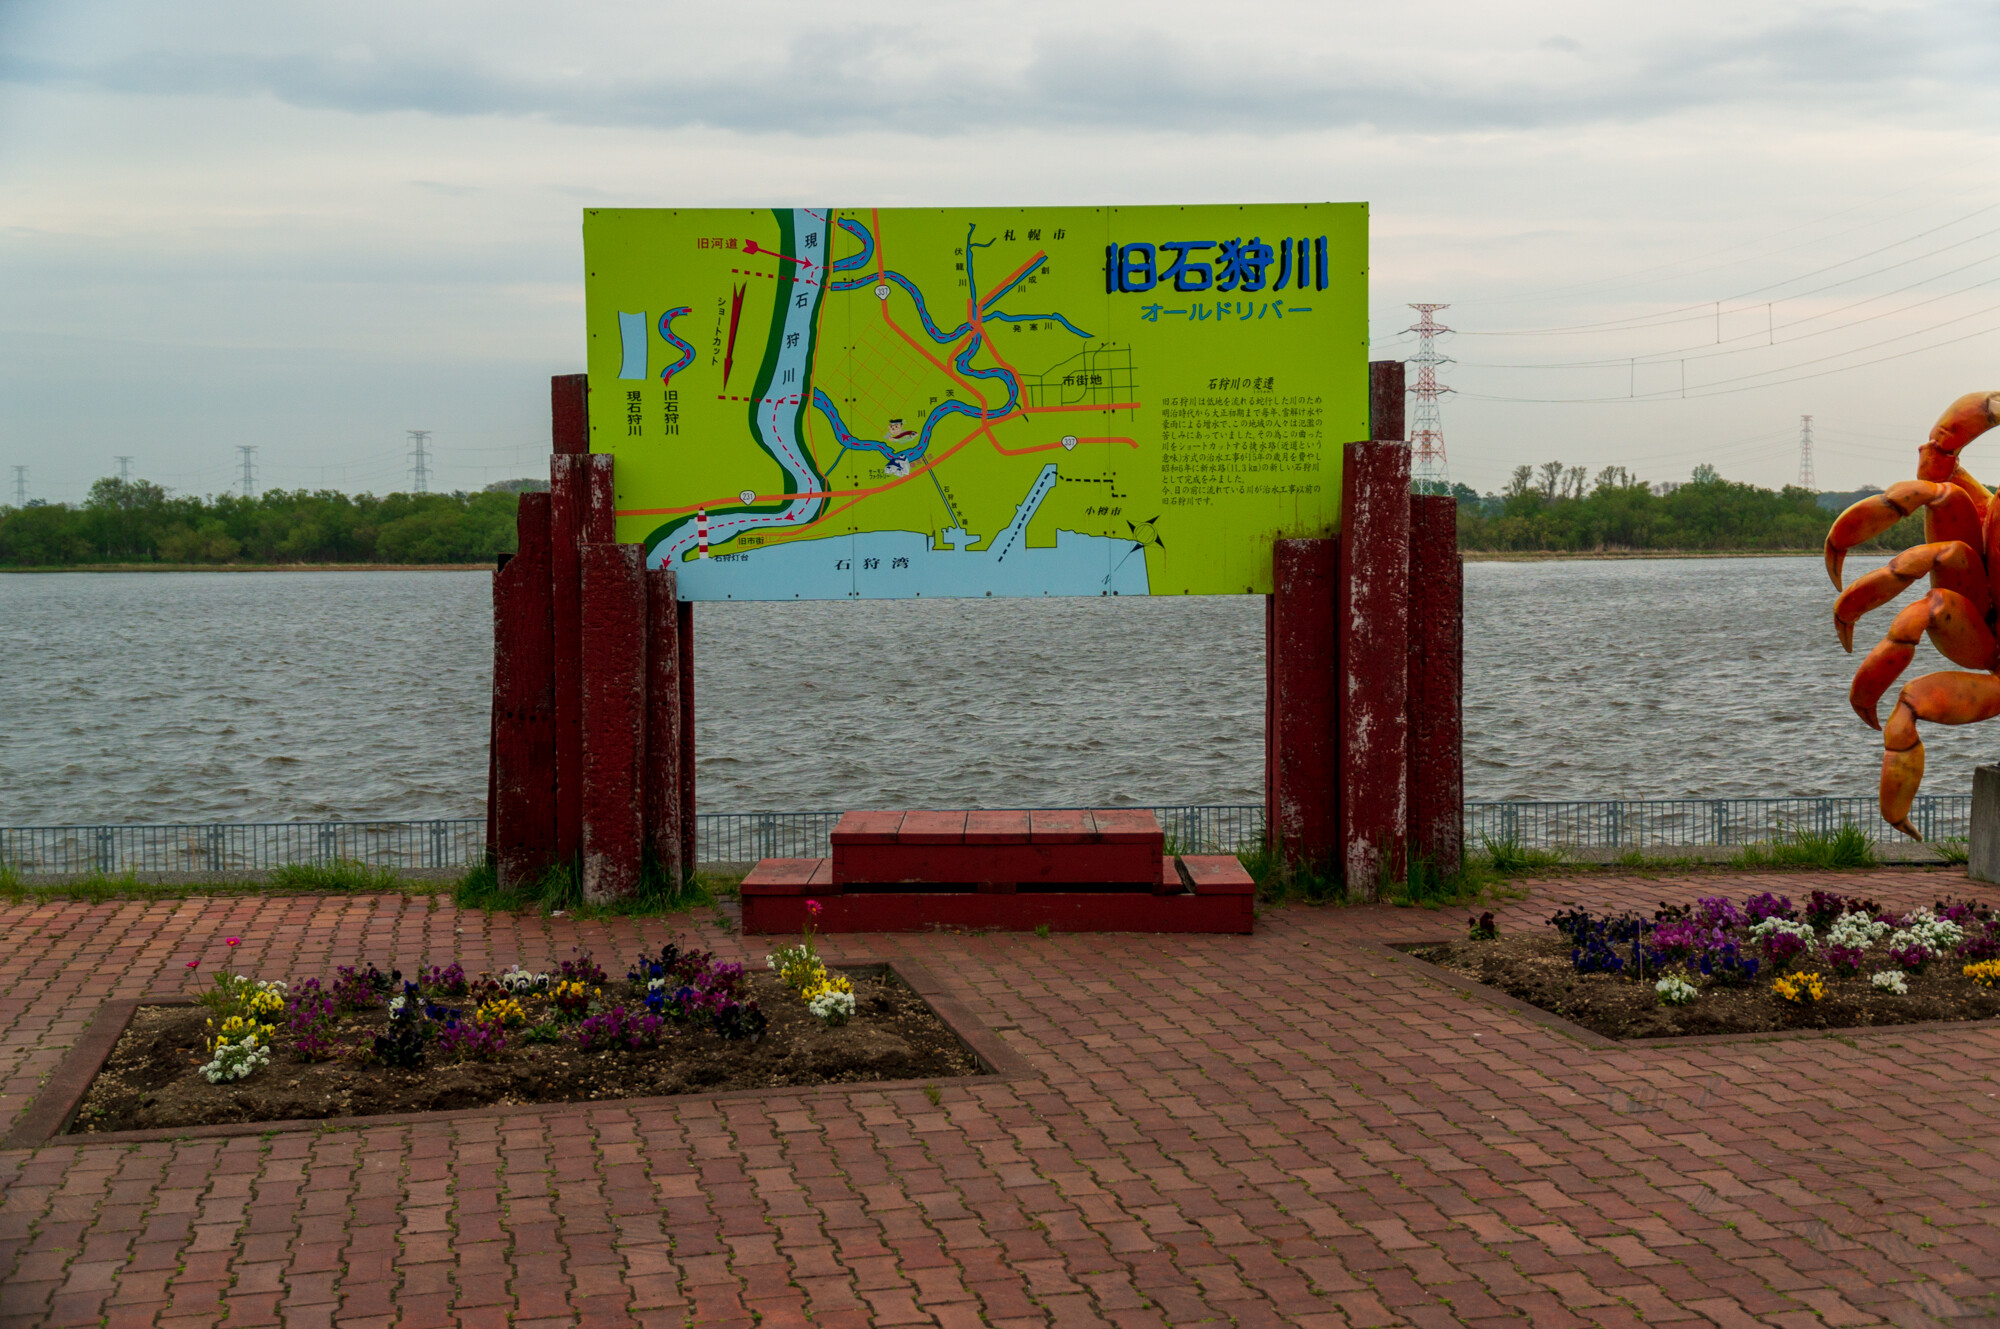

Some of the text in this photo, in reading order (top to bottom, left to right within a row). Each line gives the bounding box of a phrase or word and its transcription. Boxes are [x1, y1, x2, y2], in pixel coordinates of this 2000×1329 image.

[1004, 228, 1066, 241] 札幌市
[697, 237, 738, 249] 旧河道
[1105, 235, 1329, 294] 旧石狩川
[877, 287, 889, 296] 337
[782, 232, 818, 385] 現石狩川
[1141, 299, 1312, 322] オールドリバー
[711, 297, 726, 366] ショートカット
[1062, 374, 1103, 387] 市街地
[1207, 376, 1275, 391] 石狩川の変遷
[627, 391, 642, 437] 現石狩川
[664, 390, 679, 436] 旧石狩川
[1065, 438, 1075, 447] 337
[742, 492, 753, 501] 231
[1085, 505, 1122, 516] 小樽市
[738, 535, 765, 545] 旧市街
[714, 553, 749, 562] 石狩灯台
[834, 556, 910, 571] 石狩湾
